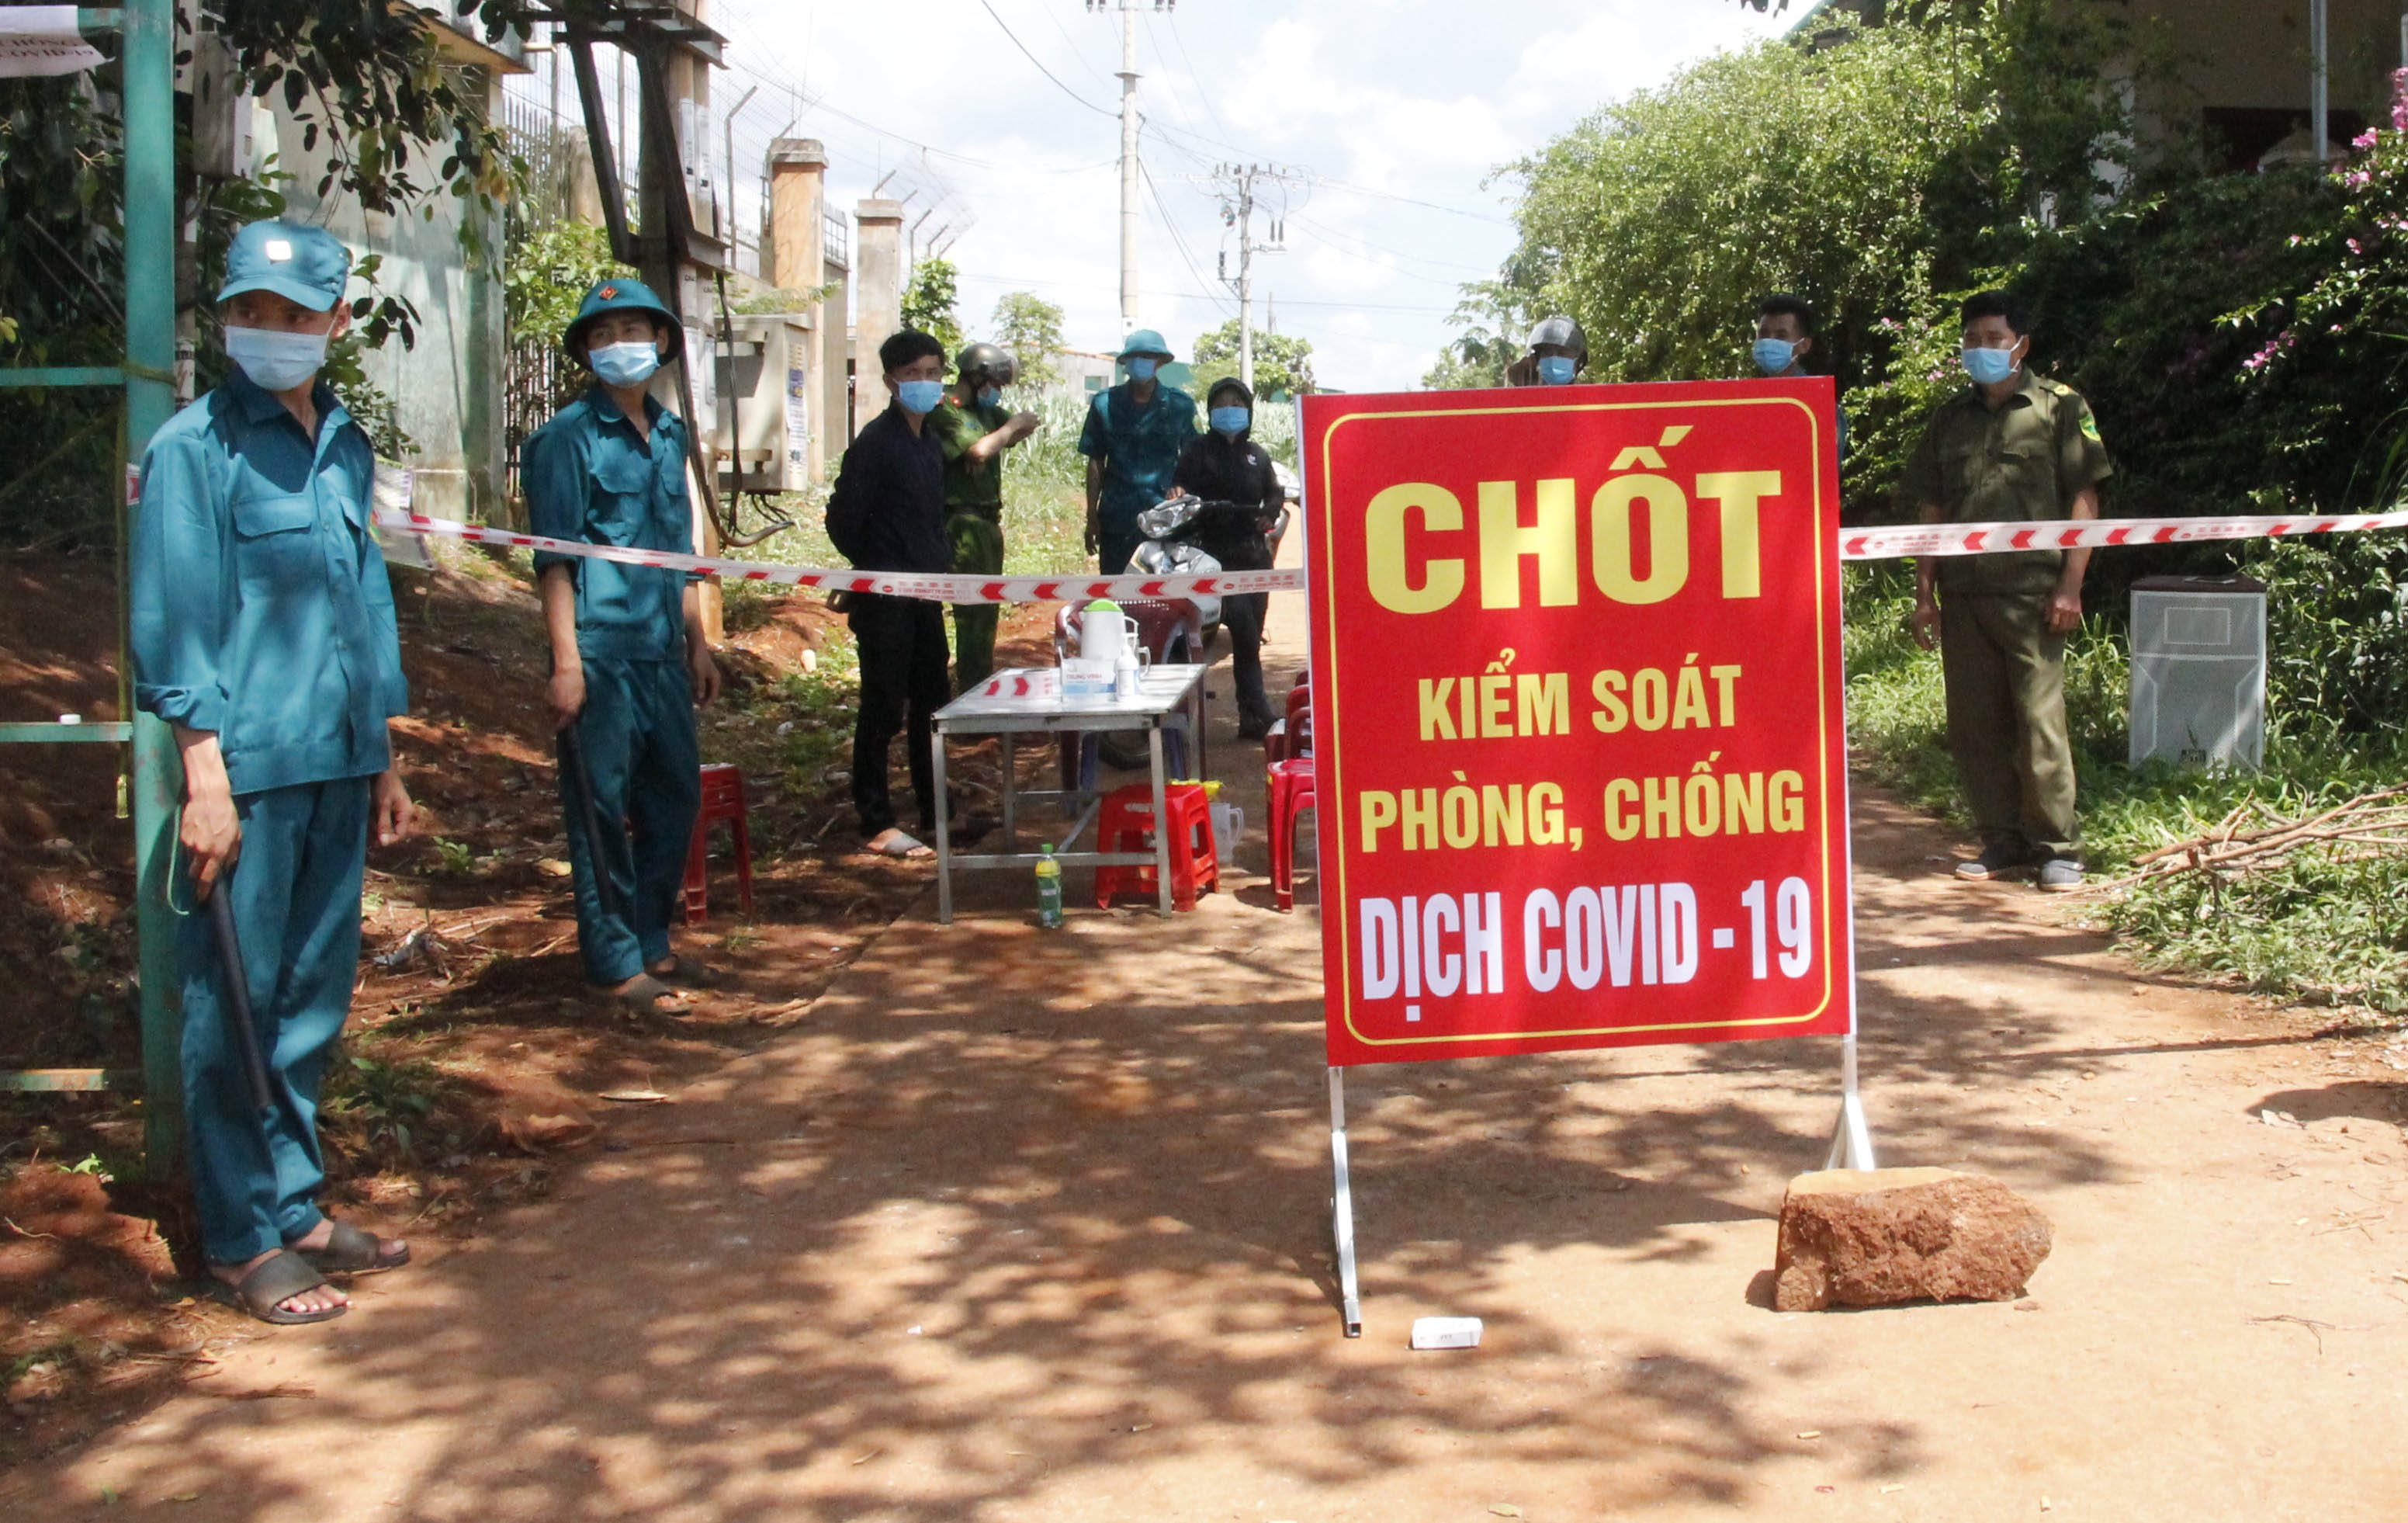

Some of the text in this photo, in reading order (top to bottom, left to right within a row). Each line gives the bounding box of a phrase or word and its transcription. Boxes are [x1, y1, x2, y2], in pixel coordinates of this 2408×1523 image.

[1366, 425, 1782, 615] CHỐT
[1419, 647, 1742, 741] KIỂM SOÁT
[1360, 751, 1805, 853] PHÒNG, CHỐNG
[1360, 891, 1505, 1022] DỊCH
[1524, 882, 1699, 993] COVID
